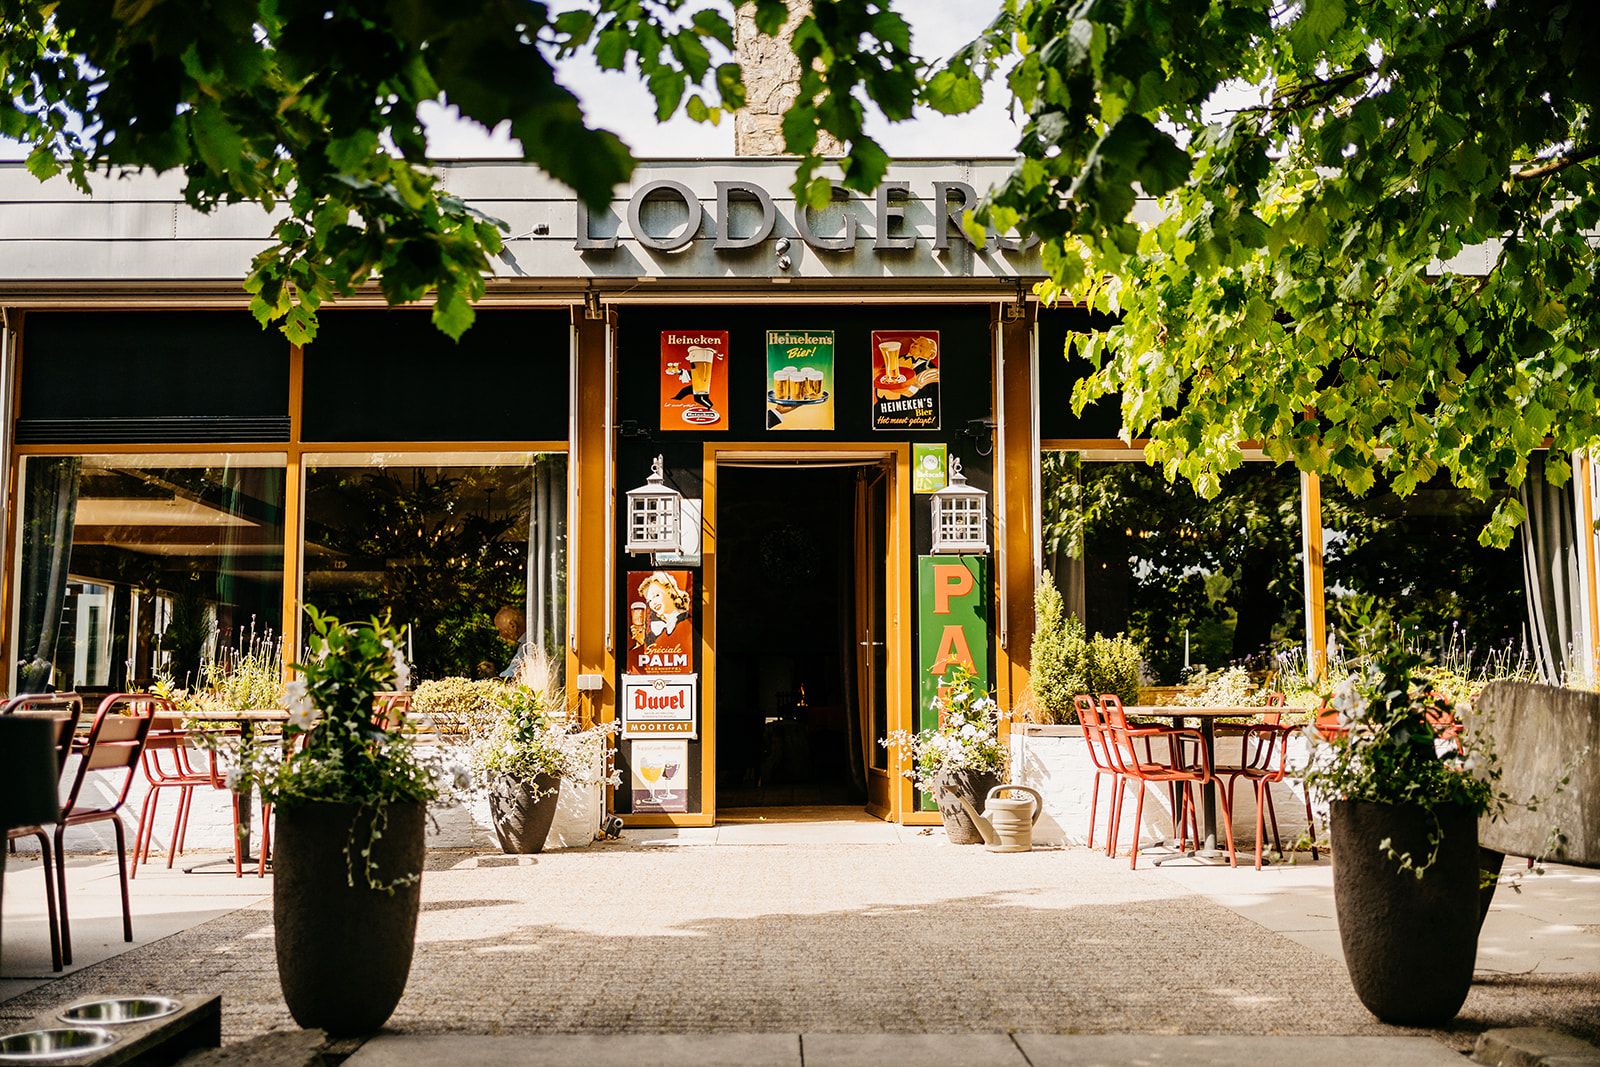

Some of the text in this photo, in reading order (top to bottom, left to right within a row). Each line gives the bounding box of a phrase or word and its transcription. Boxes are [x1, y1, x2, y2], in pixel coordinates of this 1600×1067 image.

[668, 334, 721, 345] Heineken
[786, 346, 817, 359] Bier!
[880, 397, 933, 413] HEINEKEN'S
[915, 408, 933, 417] Bier
[931, 564, 978, 735] PA
[638, 654, 688, 667] PALM
[634, 688, 685, 710] Duvel
[630, 723, 689, 731] MOORTGAT
